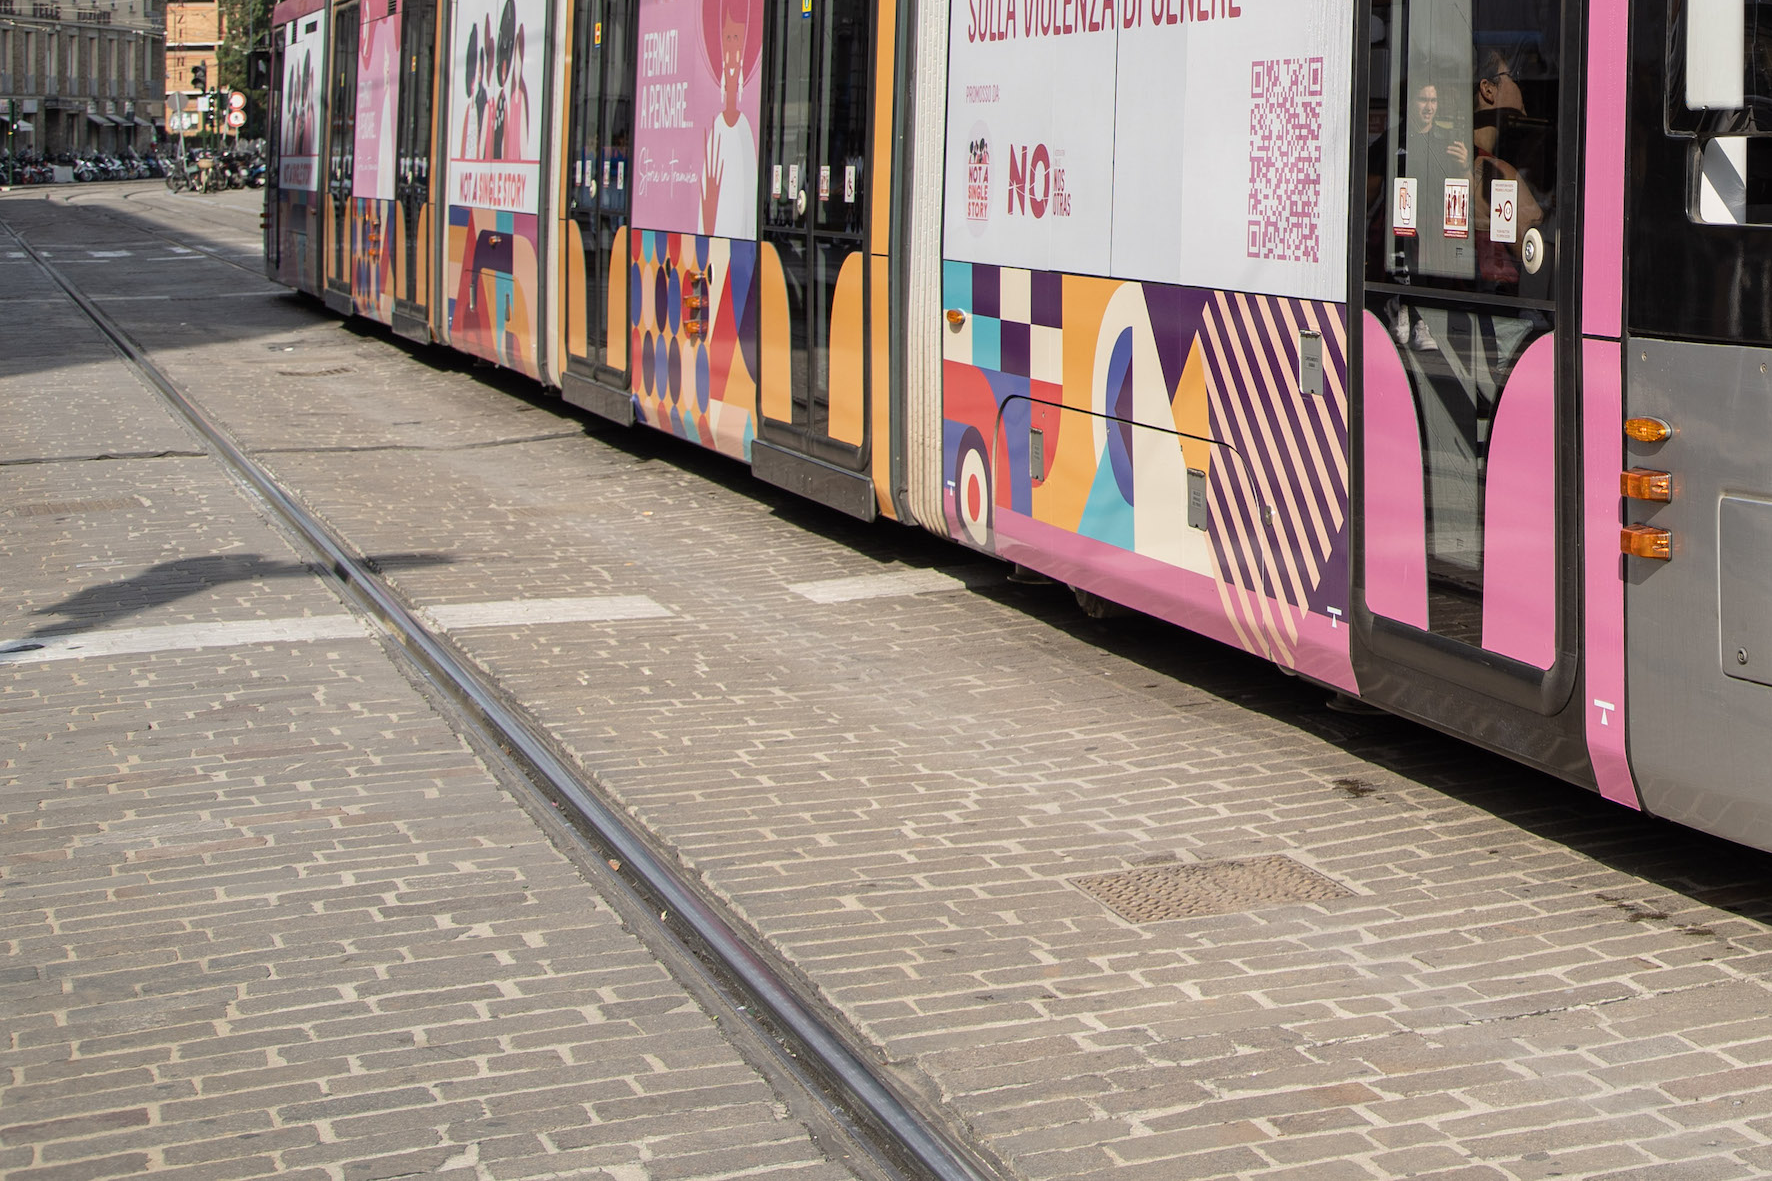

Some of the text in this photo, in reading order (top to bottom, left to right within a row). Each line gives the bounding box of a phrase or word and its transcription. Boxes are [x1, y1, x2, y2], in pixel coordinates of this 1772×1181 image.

[643, 29, 678, 77] FERMATI
[640, 82, 693, 129] A PENSARE...
[966, 85, 991, 103] PROMOSSO
[968, 166, 989, 184] NOT A
[1008, 143, 1050, 219] NO
[460, 172, 527, 208] NOT A SINGLE STORY
[967, 184, 988, 201] SINGLE
[967, 201, 988, 218] STORY
